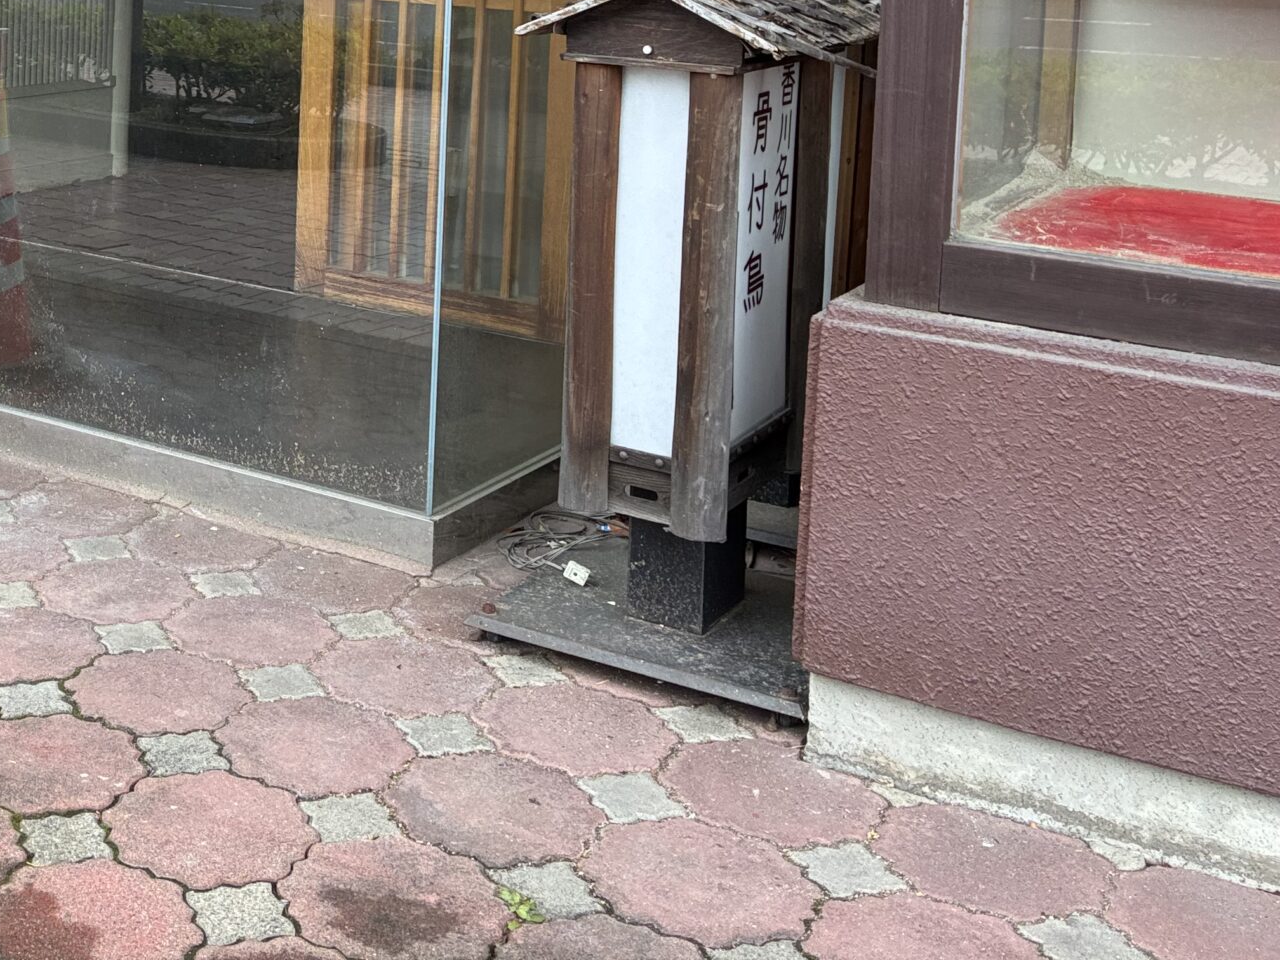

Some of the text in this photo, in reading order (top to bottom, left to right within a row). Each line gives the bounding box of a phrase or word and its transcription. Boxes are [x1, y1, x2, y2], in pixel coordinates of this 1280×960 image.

[743, 90, 773, 314] 骨付鳥
[772, 63, 796, 244] 香川名物
